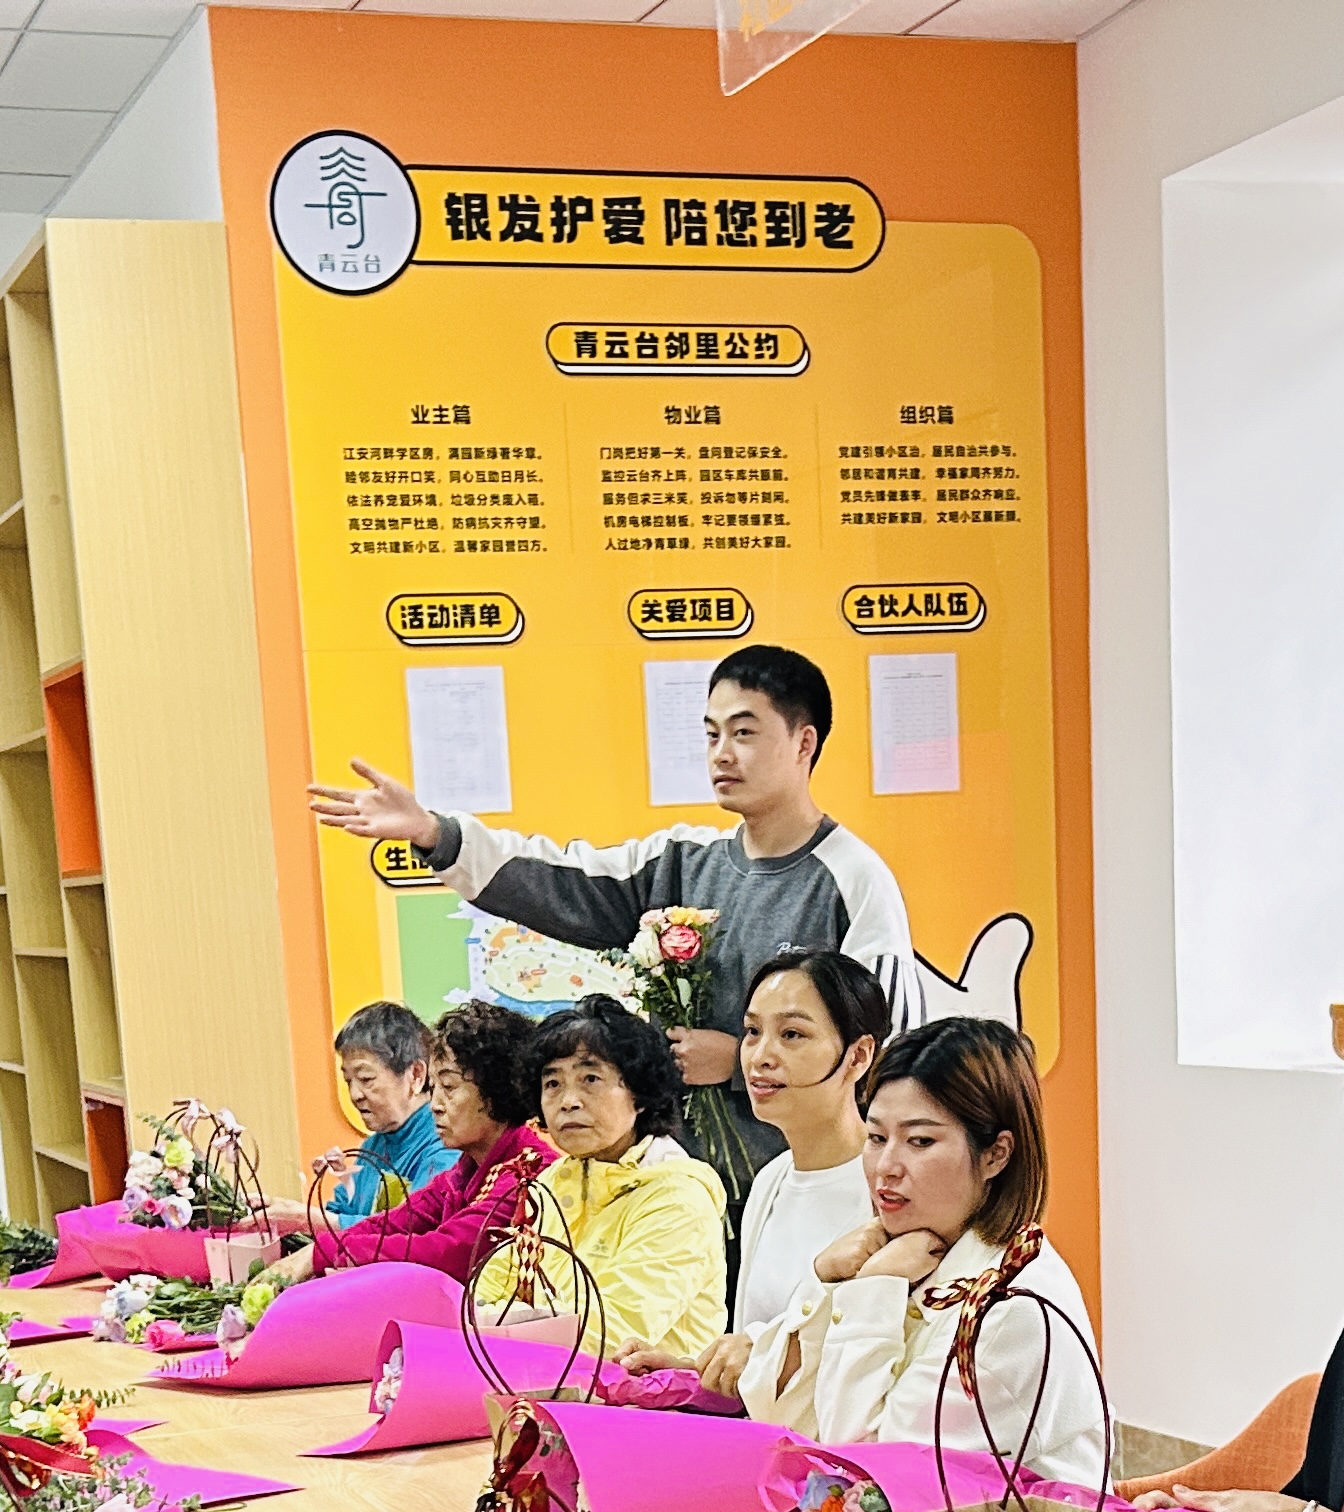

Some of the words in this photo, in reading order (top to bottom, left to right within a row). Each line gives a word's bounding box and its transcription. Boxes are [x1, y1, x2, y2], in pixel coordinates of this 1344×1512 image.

[445, 192, 645, 245] 银发护爱
[664, 198, 855, 250] 陪您到老
[318, 253, 381, 273] 青云台
[573, 331, 780, 361] 青云台邻里公约
[411, 405, 470, 424] 业主篇
[665, 406, 720, 425] 物业篇
[900, 405, 953, 424] 组织篇
[400, 604, 502, 629] 活动清单
[640, 598, 736, 624] 关爱项目
[854, 593, 969, 619] 合伙人队伍
